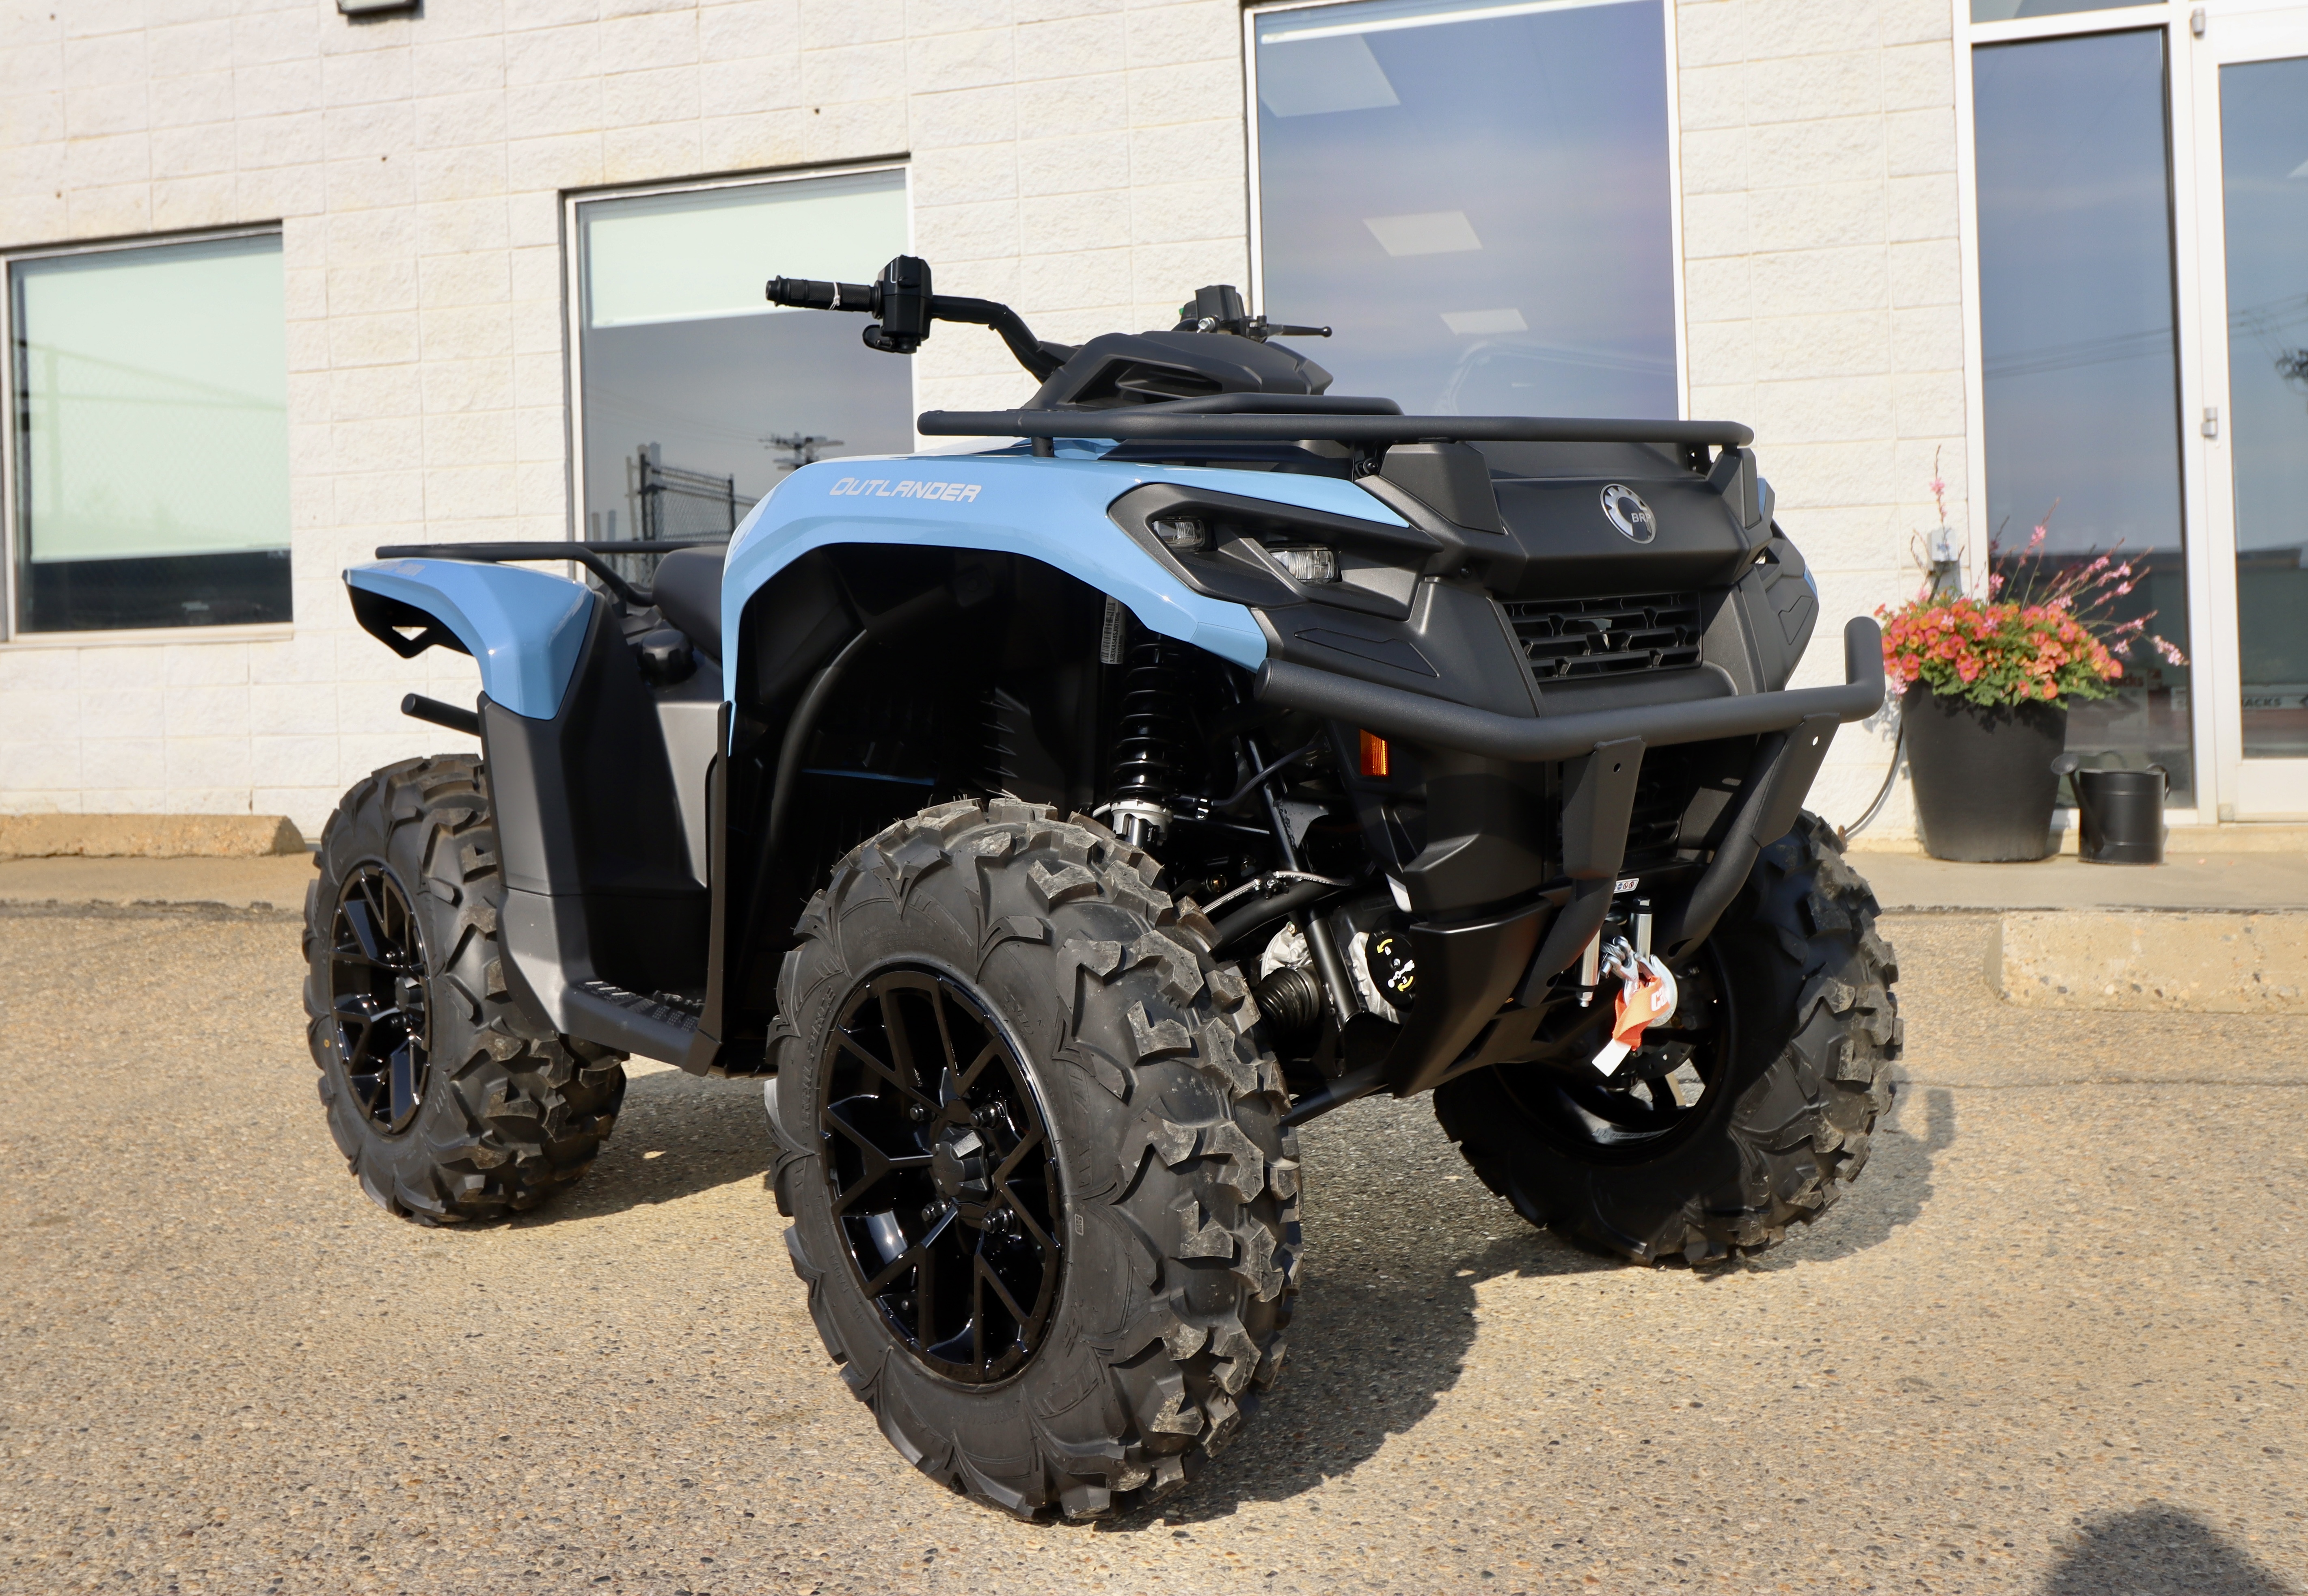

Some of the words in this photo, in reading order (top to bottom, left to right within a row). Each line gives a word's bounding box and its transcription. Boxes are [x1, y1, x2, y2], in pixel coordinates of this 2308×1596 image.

[829, 477, 982, 503] OUTLANDER
[1631, 512, 1651, 523] BRP
[1651, 986, 1668, 1011] Ca
